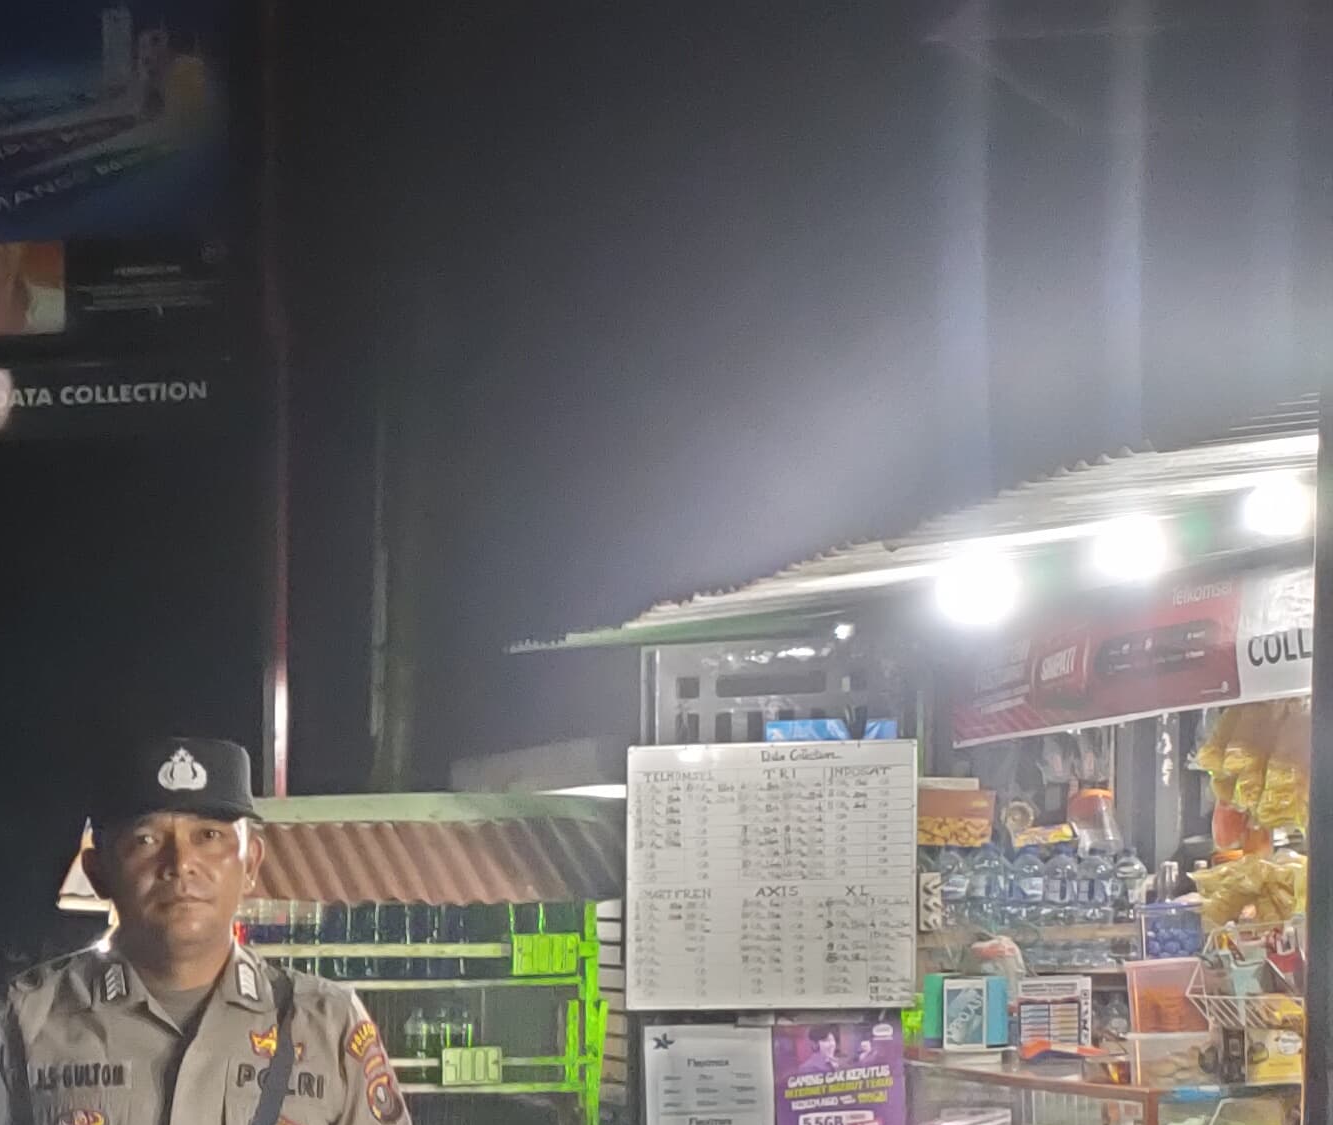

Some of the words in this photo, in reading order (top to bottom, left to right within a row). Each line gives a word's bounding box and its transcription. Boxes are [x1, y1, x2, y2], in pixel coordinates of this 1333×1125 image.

[60, 381, 208, 406] COLLECTION
[755, 885, 799, 898] AXIS
[844, 884, 870, 897] XL
